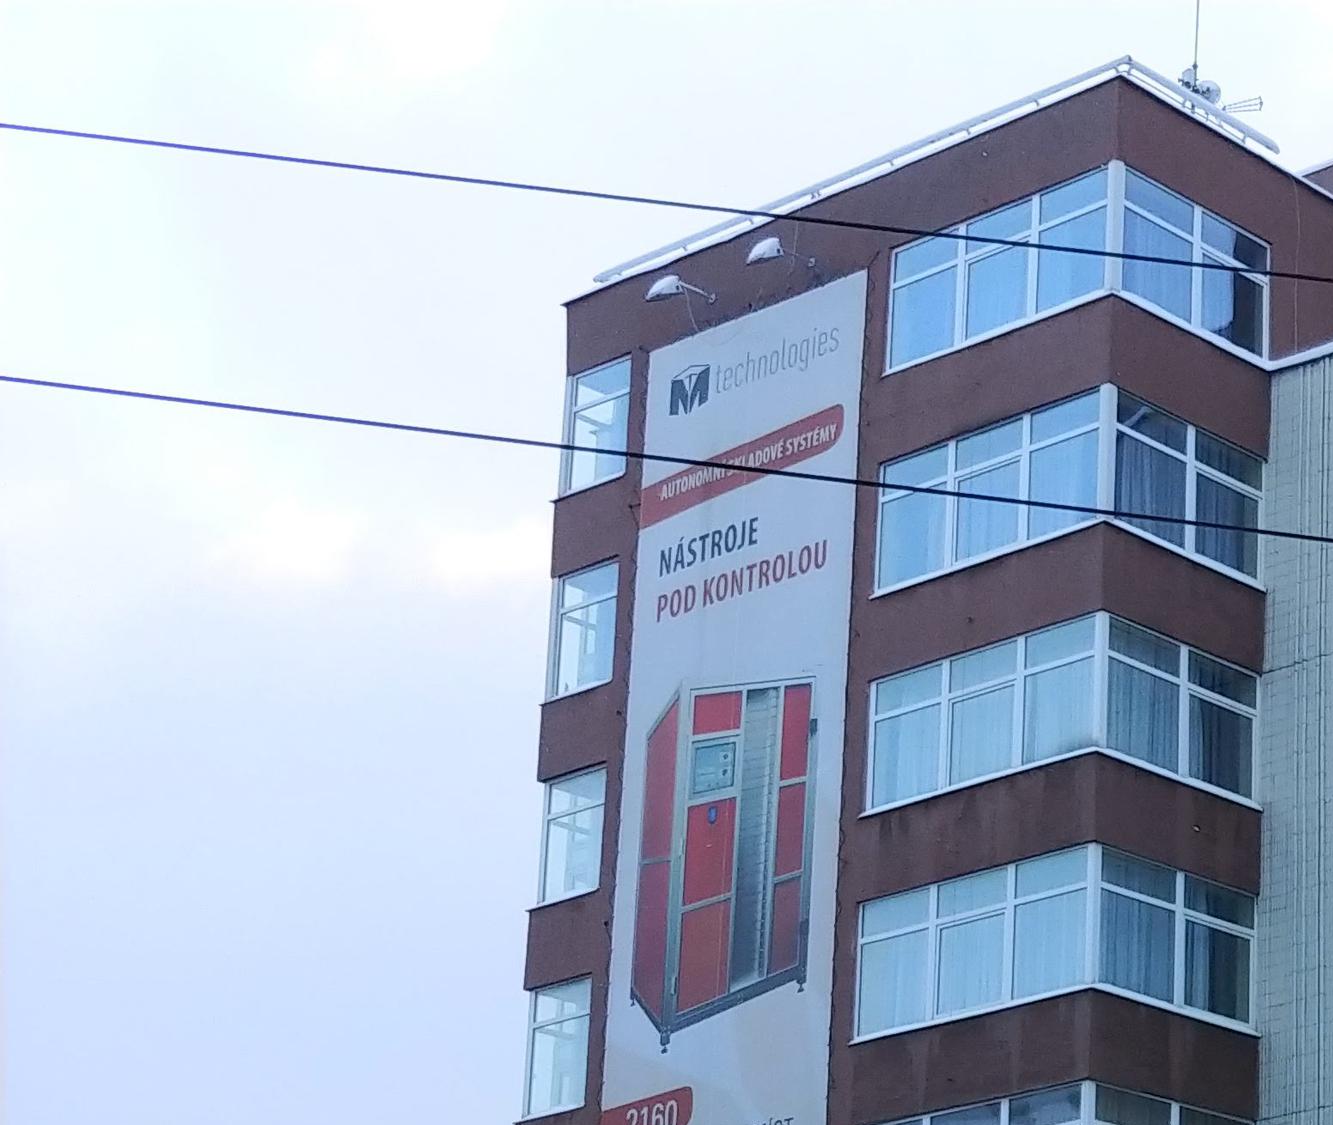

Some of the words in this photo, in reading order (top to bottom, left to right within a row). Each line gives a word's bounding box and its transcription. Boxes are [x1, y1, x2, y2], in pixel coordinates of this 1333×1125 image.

[715, 327, 841, 394] technologies
[785, 423, 837, 455] SYSTÉMY
[660, 517, 760, 577] NÁSTROJE
[657, 582, 696, 622] POD
[702, 540, 829, 605] KONTROLOU
